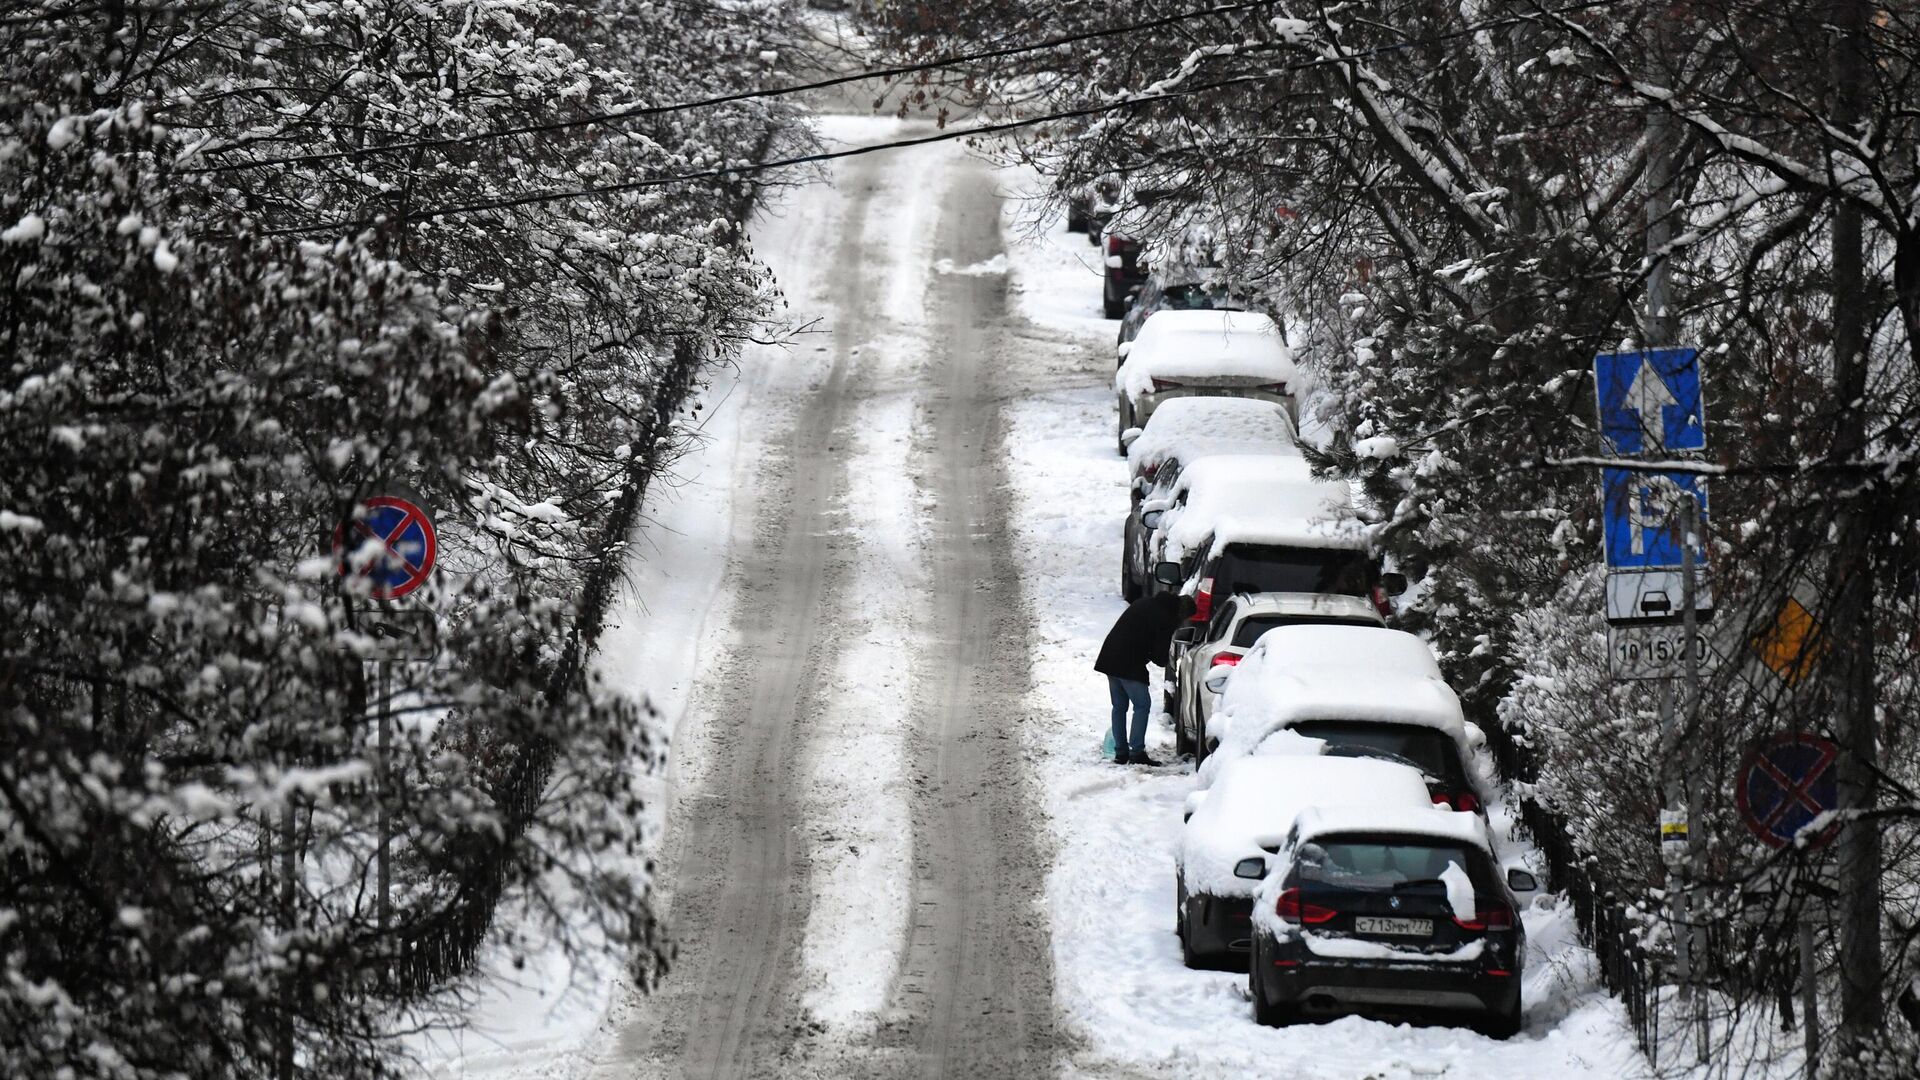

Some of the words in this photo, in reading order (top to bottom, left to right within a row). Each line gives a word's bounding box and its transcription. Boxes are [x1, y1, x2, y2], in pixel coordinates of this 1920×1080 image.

[1629, 473, 1682, 554] P
[1620, 644, 1638, 660] 10
[1647, 639, 1668, 661] 15
[1677, 636, 1706, 661] 20
